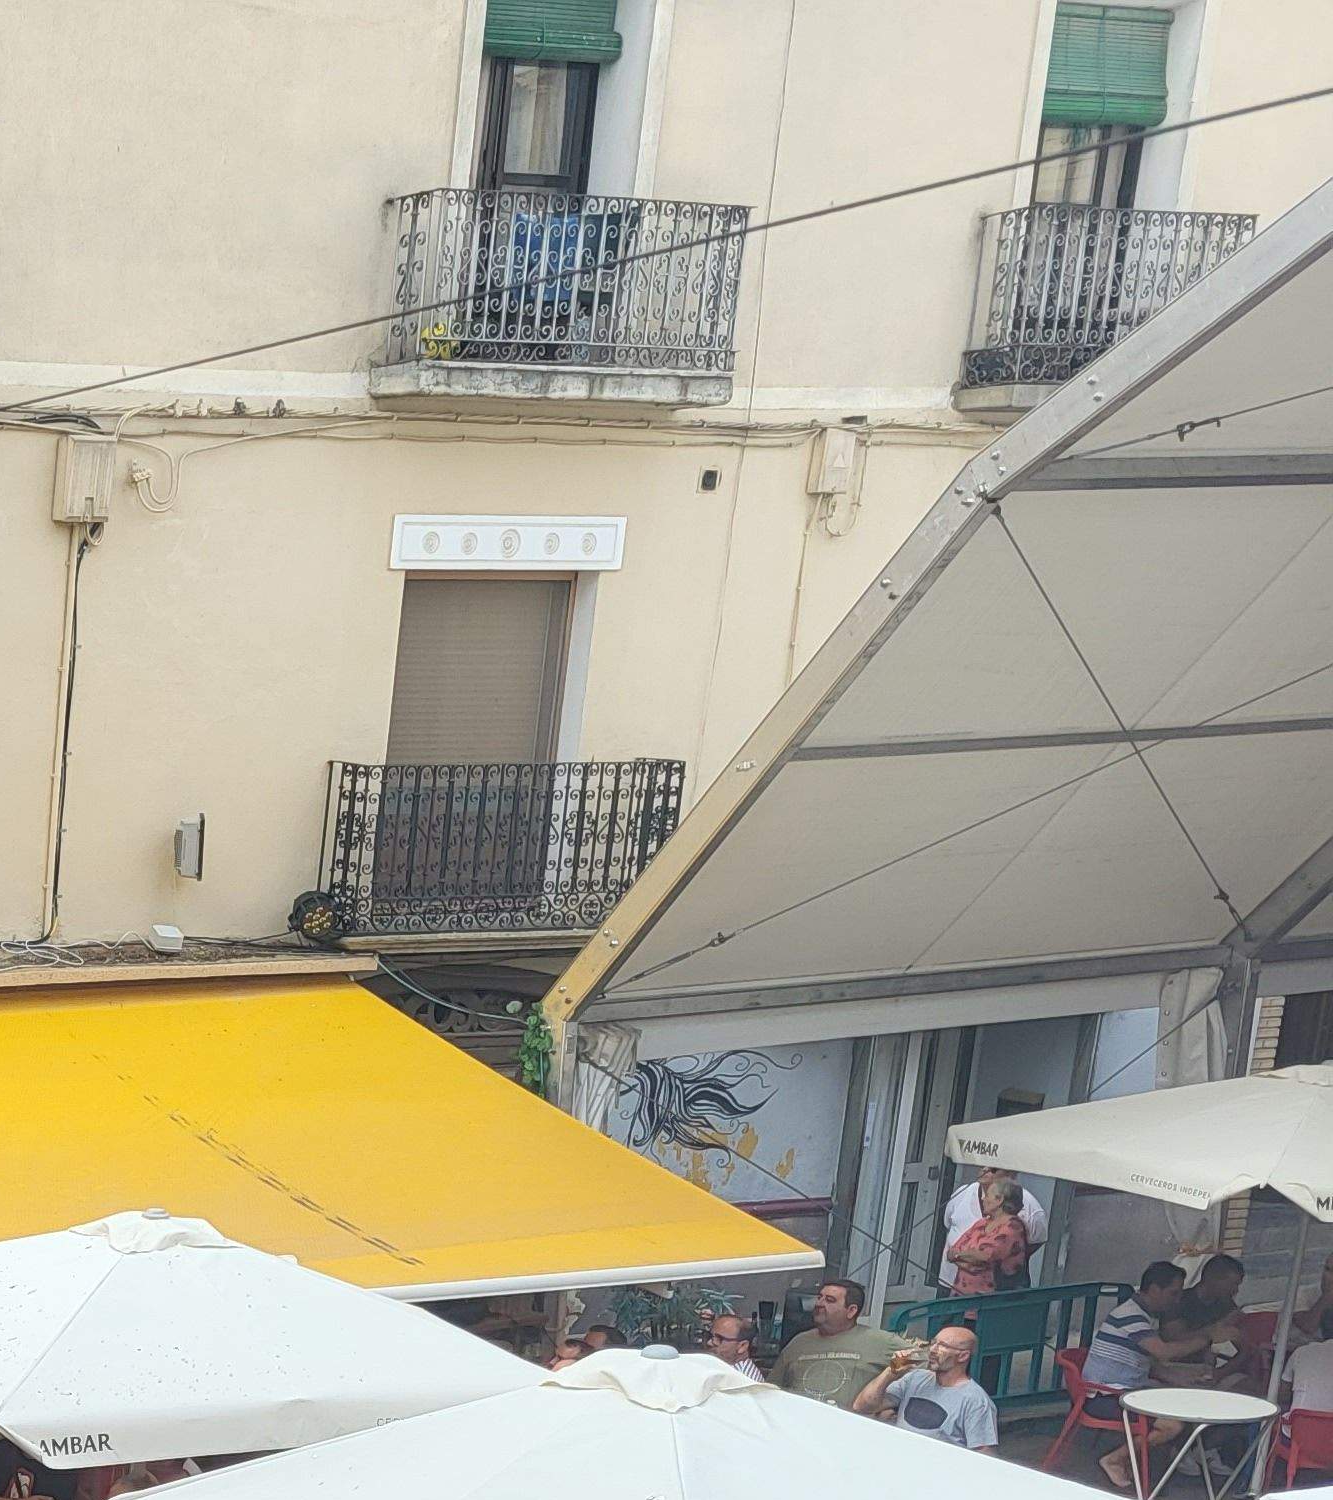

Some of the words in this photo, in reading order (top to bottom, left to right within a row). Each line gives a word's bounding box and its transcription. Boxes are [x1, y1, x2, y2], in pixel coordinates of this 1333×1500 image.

[964, 1140, 999, 1157] AMBAR
[1131, 1173, 1178, 1191] CERVECEROS
[40, 1434, 115, 1456] AMBAR
